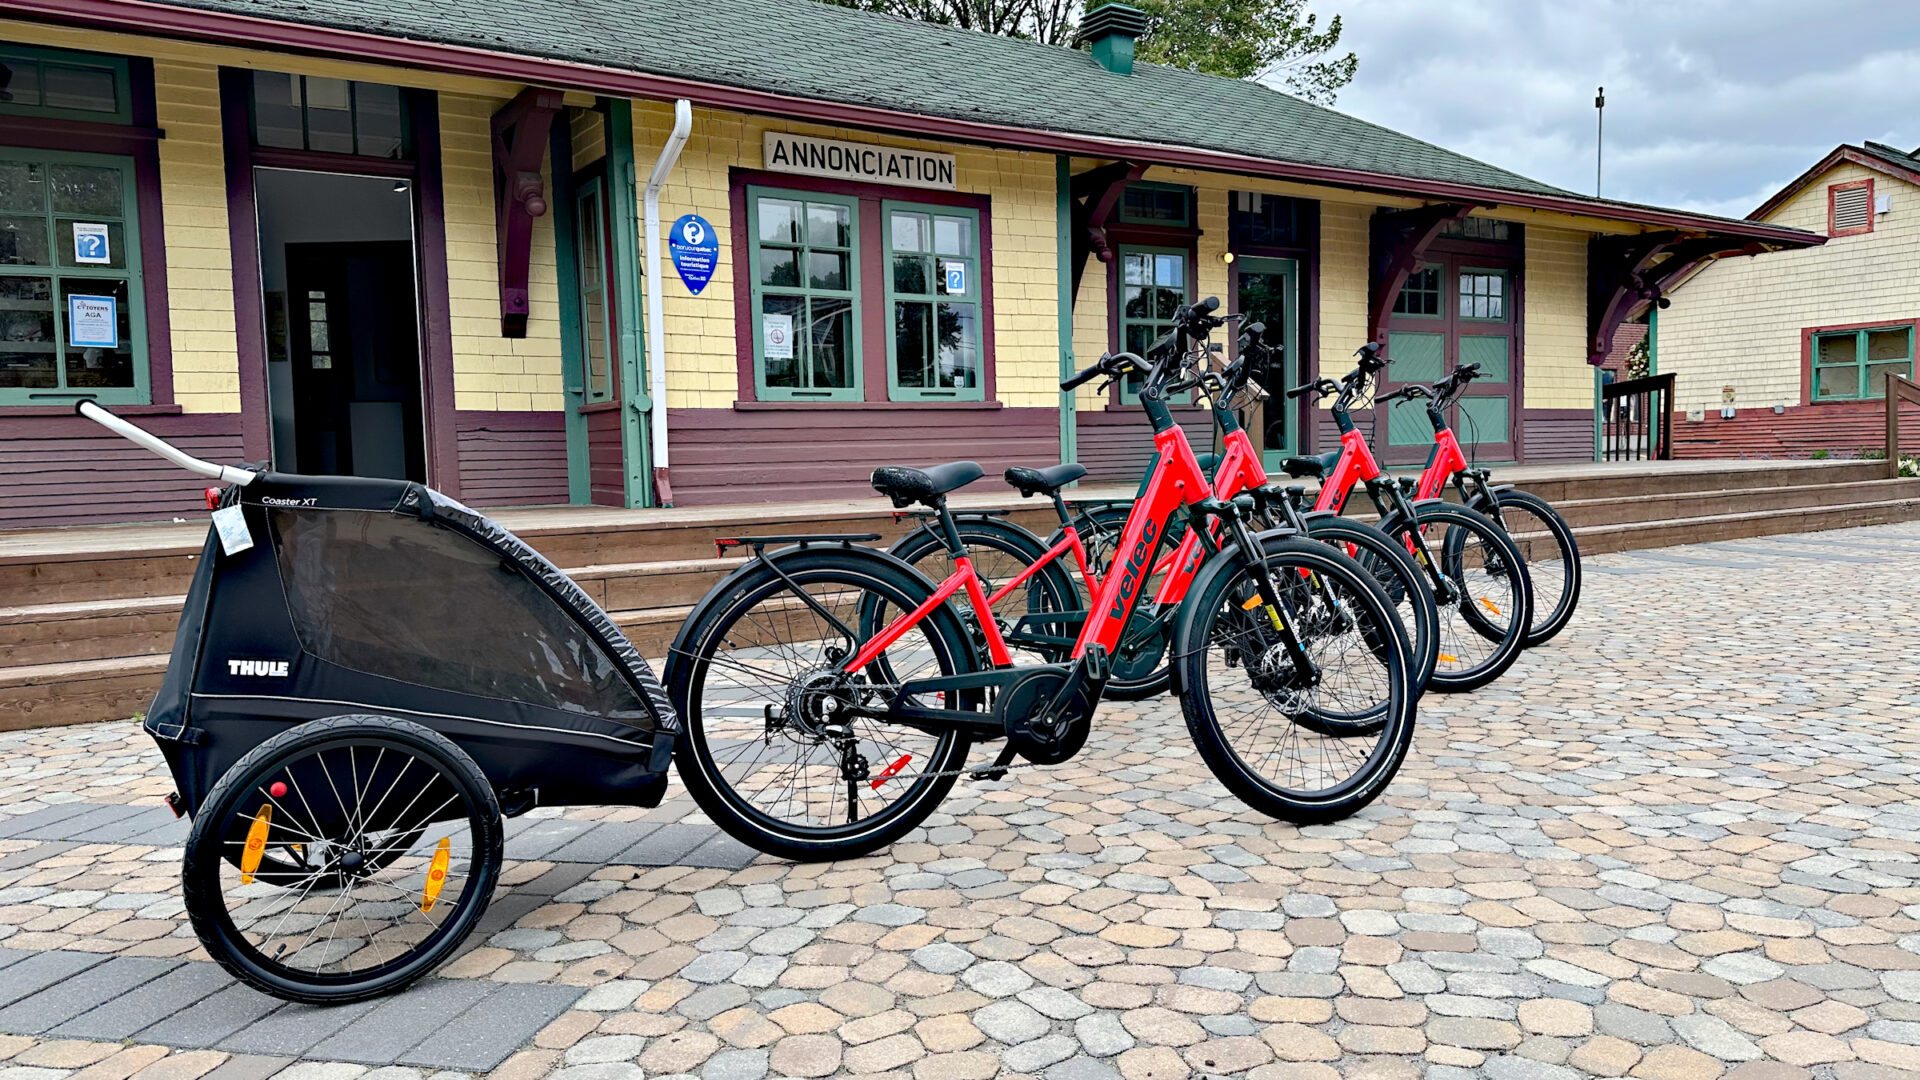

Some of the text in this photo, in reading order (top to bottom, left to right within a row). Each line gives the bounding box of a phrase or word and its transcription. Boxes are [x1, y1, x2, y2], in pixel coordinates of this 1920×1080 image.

[772, 139, 953, 184] ANNONCIATION
[262, 496, 318, 506] Coaster XT
[1110, 518, 1157, 620] velec
[228, 659, 289, 676] THULE
